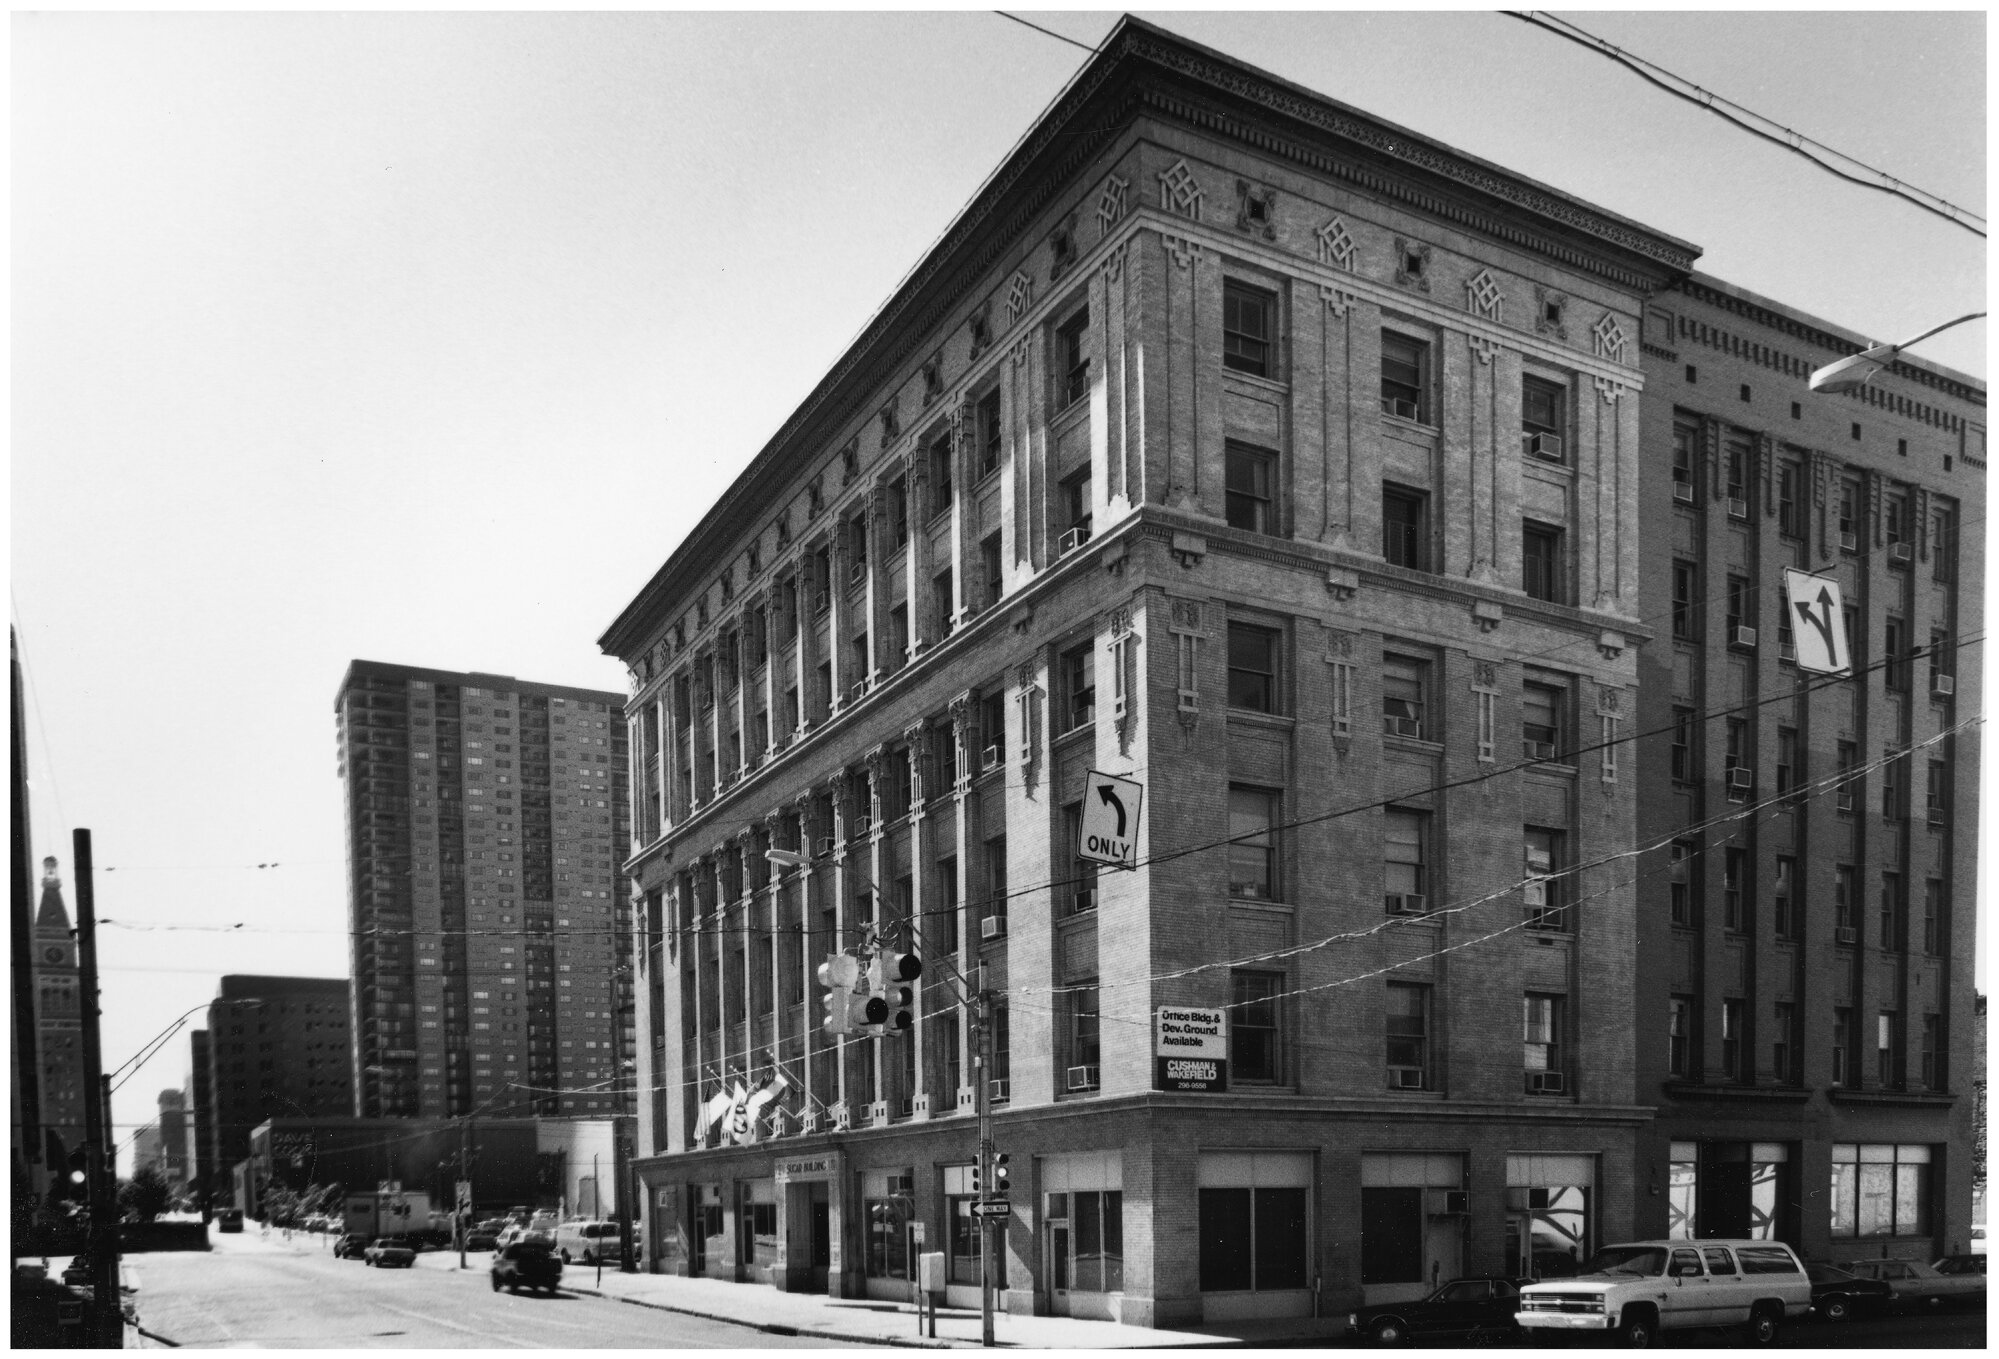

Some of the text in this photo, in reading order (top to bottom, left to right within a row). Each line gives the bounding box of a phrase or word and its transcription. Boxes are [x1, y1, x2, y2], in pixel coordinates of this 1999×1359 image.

[1088, 835, 1130, 859] ONLY
[1162, 1010, 1221, 1025] Office Bldg. &
[1162, 1023, 1217, 1035] Dev. Ground
[1163, 1036, 1203, 1047] Available
[1167, 1060, 1216, 1072] CUSHMAN &
[1167, 1070, 1217, 1080] WAKEFIELD
